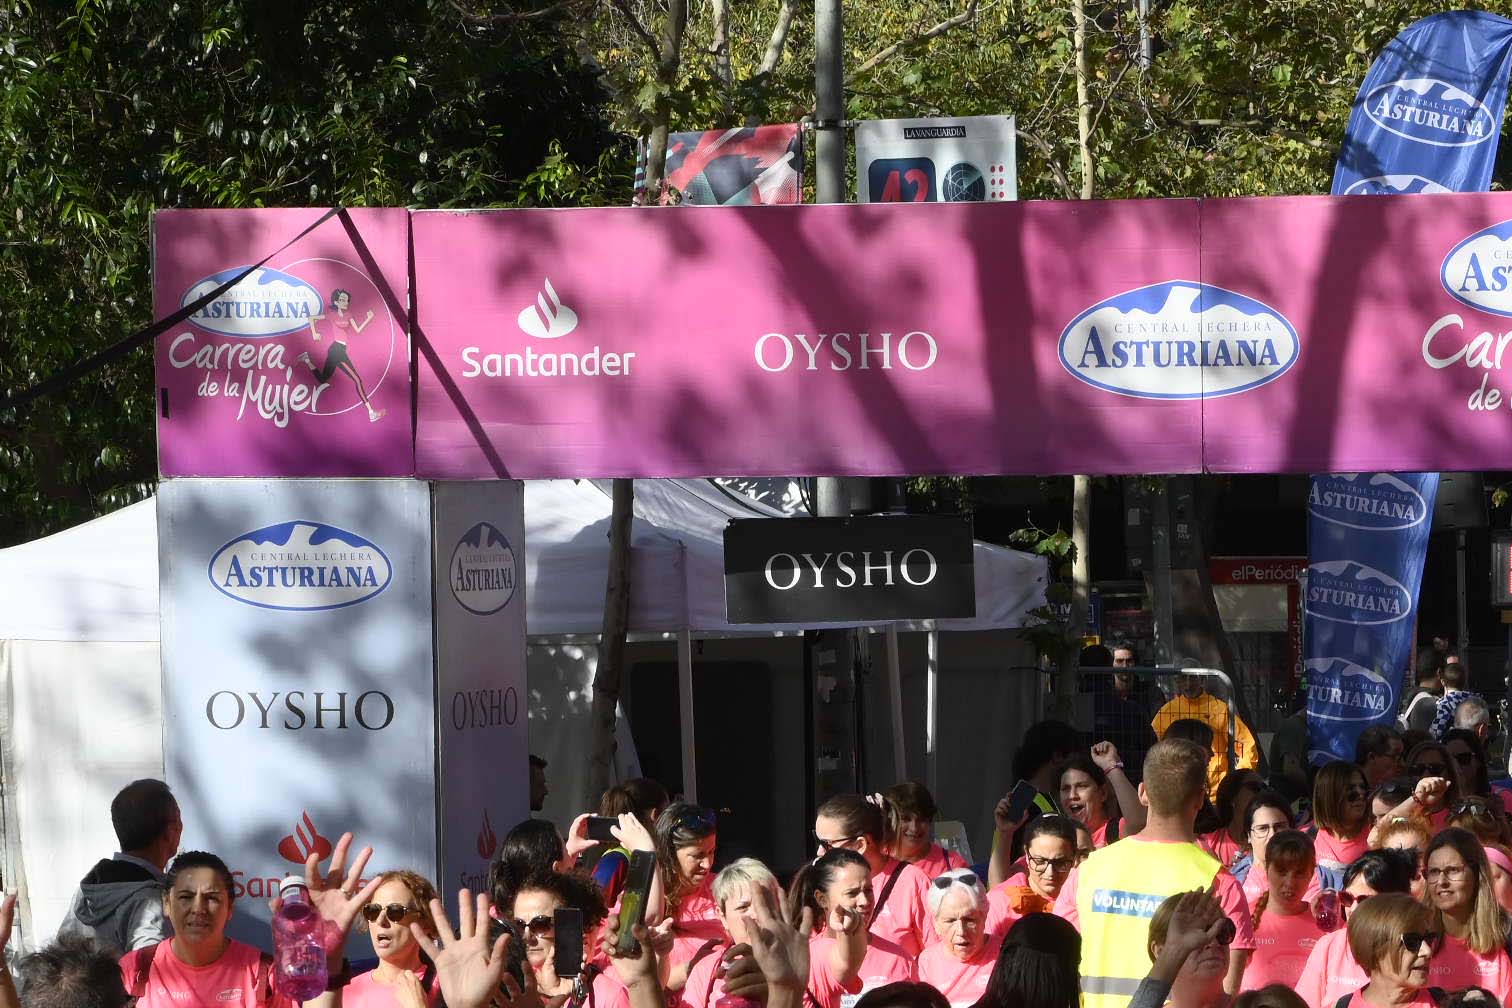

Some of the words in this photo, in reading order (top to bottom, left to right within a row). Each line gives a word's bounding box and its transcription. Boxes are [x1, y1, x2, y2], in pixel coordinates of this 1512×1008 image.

[1372, 92, 1484, 137] ASTURIANA
[1077, 326, 1281, 368] ASTURIANA
[1114, 321, 1194, 334] CENTRAL
[1198, 321, 1274, 334] LECHERA
[169, 332, 286, 370] Carrera
[462, 346, 635, 378] Santander
[755, 332, 937, 371] OYSHO
[198, 371, 219, 397] de
[224, 370, 240, 397] la
[237, 366, 331, 428] Mujer
[1468, 372, 1503, 412] de
[1308, 480, 1416, 521] ASTURIANA
[223, 554, 378, 588] ASTURIANA
[250, 552, 309, 561] CENTRAL
[314, 552, 372, 561] LECHERA
[455, 555, 514, 593] ASTURIANA
[764, 548, 937, 592] OYSHO
[1231, 564, 1305, 581] elPeriódi
[1308, 587, 1402, 614] STURIANA
[205, 690, 395, 731] OYSHO
[452, 686, 518, 732] OYSHO
